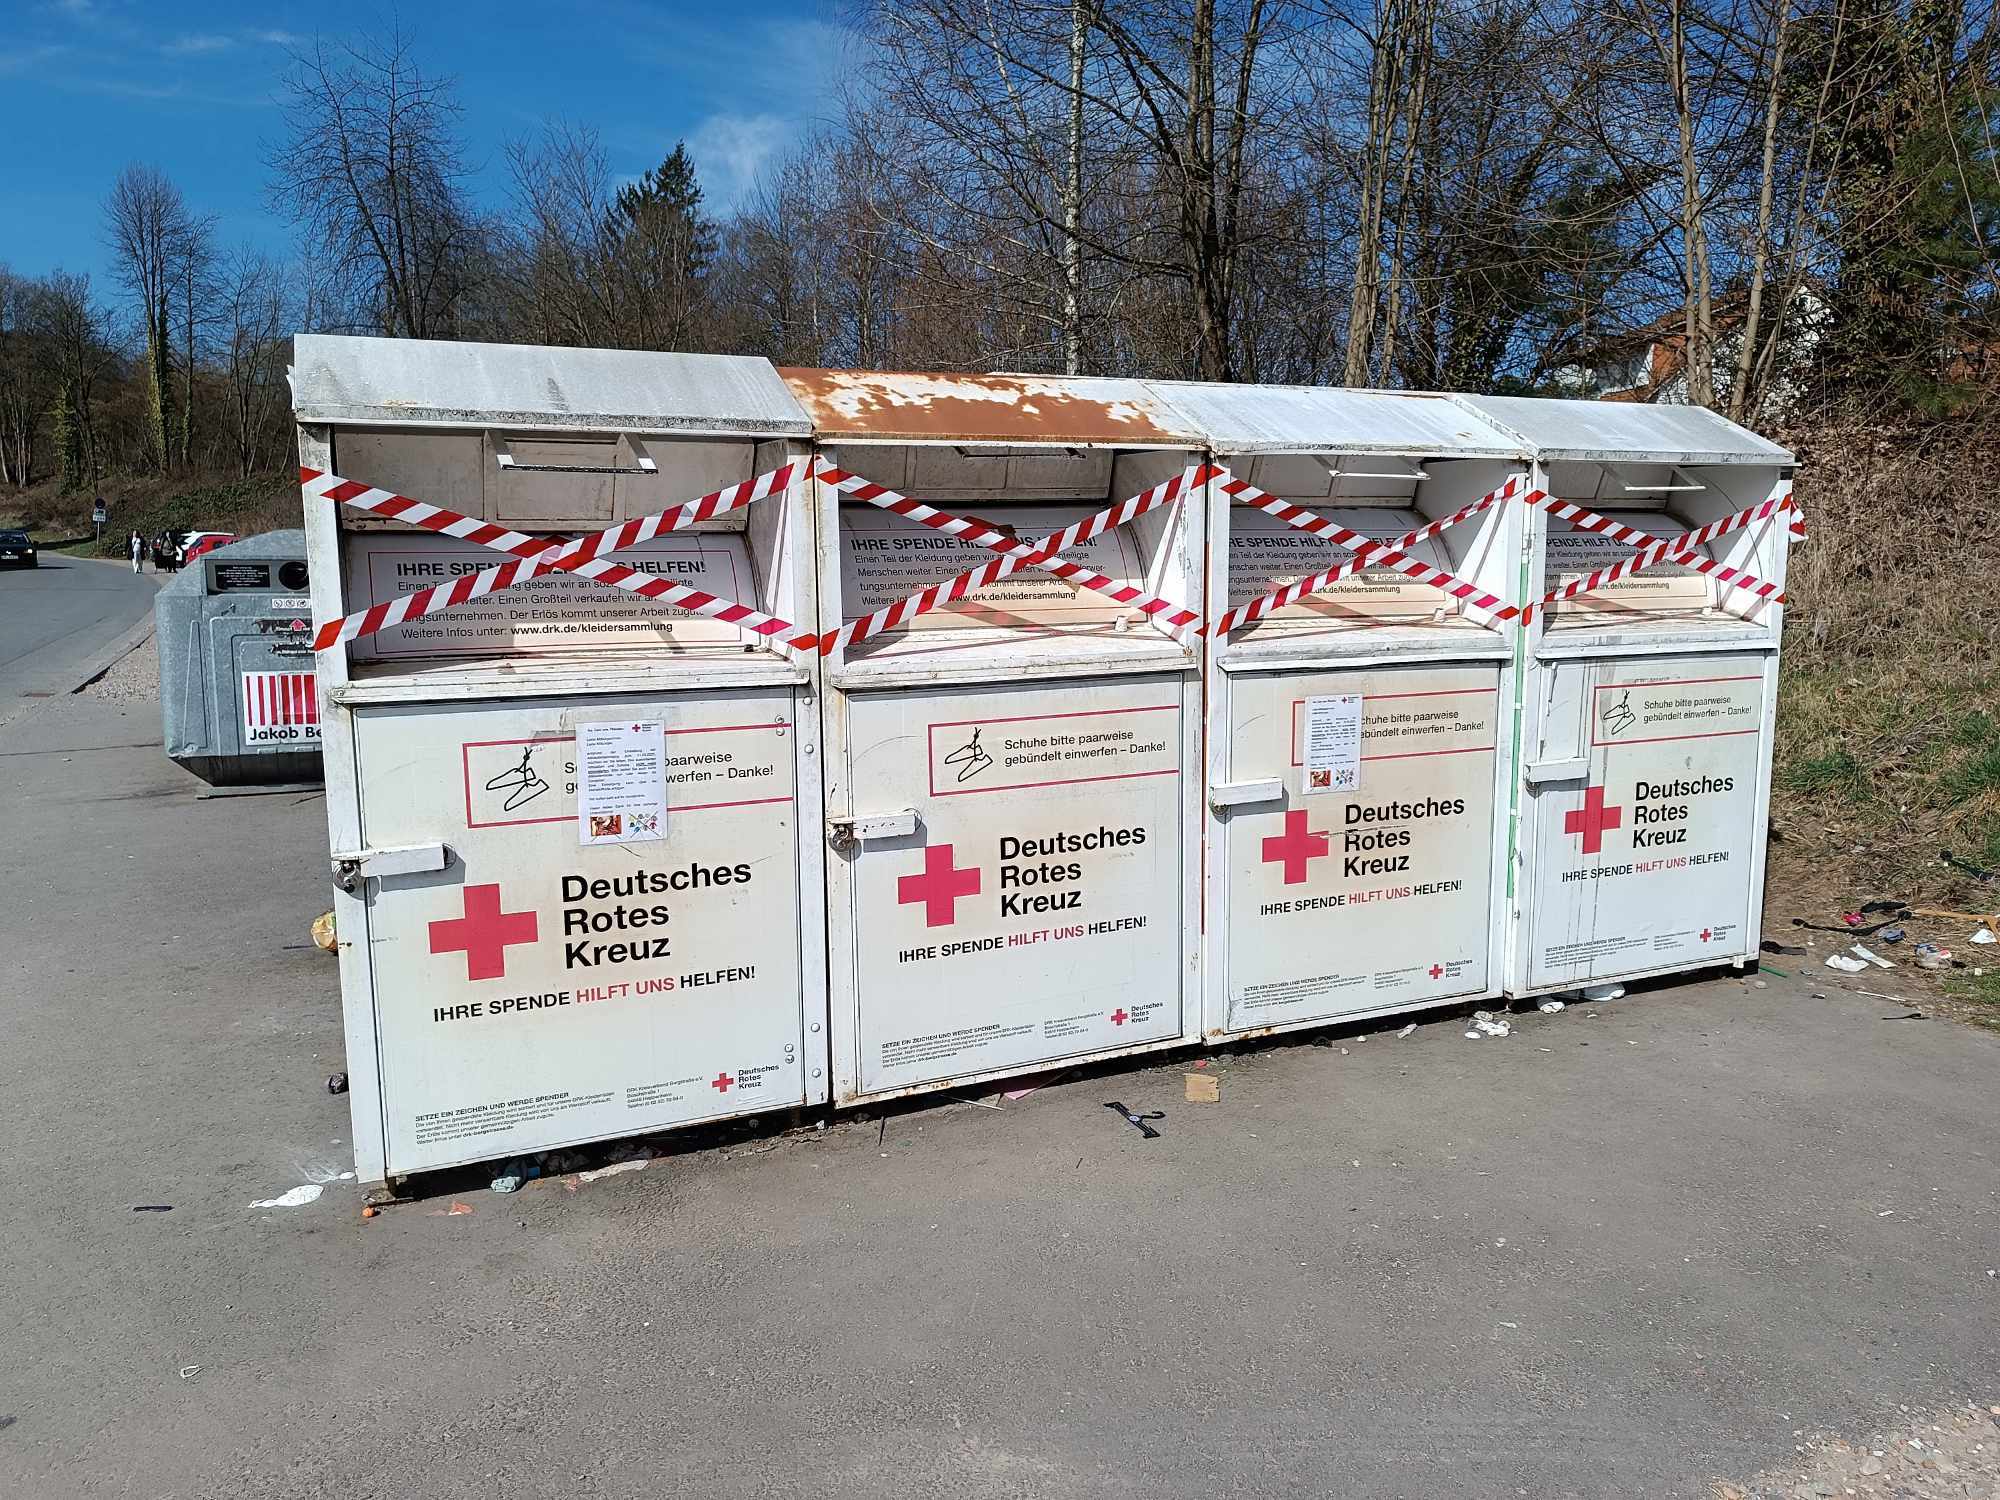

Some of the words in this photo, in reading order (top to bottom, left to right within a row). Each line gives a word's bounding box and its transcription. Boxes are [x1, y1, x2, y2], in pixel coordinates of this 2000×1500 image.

[851, 538, 891, 551] IHRE
[893, 537, 955, 550] SPENDE
[1248, 536, 1299, 548] SPENDE
[1547, 537, 1581, 548] PENDE
[1584, 537, 1609, 547] HILFT
[855, 554, 880, 564] Einen
[881, 554, 896, 563] Teil
[899, 553, 913, 563] der
[915, 553, 953, 564] Kleidung
[955, 553, 980, 563] geben
[982, 553, 994, 561] wir
[1284, 561, 1303, 570] Einen
[397, 562, 444, 577] IHRE
[632, 561, 706, 575] HELFEN!
[857, 568, 903, 577] Menschen
[936, 566, 959, 575] Einen
[398, 581, 429, 591] Einen
[521, 580, 557, 592] geben
[561, 580, 576, 589] wir
[578, 581, 591, 589] an
[499, 594, 528, 605] Einen
[531, 593, 572, 604] Großteil
[575, 592, 625, 603] verkaufen
[627, 592, 641, 602] wir
[862, 595, 895, 606] Weitere
[511, 610, 528, 621] Der
[532, 608, 558, 620] Erlös
[561, 608, 597, 618] kommt
[600, 608, 638, 618] unserer
[641, 606, 669, 617] Arbeit
[402, 627, 443, 639] Weitere
[447, 626, 474, 637] Infos
[477, 625, 507, 637] unter:
[510, 622, 673, 634] www.drk.de/kleidersammlung
[1644, 700, 1673, 709] Schuhe
[1675, 699, 1692, 708] bitte
[1693, 696, 1731, 708] paarweise
[1391, 713, 1411, 723] bitte
[1414, 710, 1459, 723] paarweise
[1643, 711, 1682, 724] gebündelt
[1684, 708, 1720, 719] einwerfen
[1728, 706, 1752, 716] Danke!
[250, 727, 299, 741] Jakob
[1402, 724, 1445, 736] einwerfen
[1455, 720, 1484, 732] Danke!
[1004, 738, 1048, 750] Schuhe
[1050, 735, 1075, 746] bitte
[1078, 730, 1134, 745] paarweise
[1004, 750, 1061, 767] gebündelt
[1065, 745, 1118, 760] einwerfen
[1129, 740, 1166, 754] Danke!
[728, 764, 774, 780] Danke!
[1636, 776, 1734, 800] Deutsches
[1345, 797, 1465, 825] Deutsches
[1634, 804, 1688, 824] Rotes
[1000, 826, 1146, 860] Deutsches
[1344, 829, 1410, 852] Rotes
[1633, 828, 1687, 848] Kreuz
[1344, 855, 1410, 877] Kreuz
[1562, 869, 1588, 882] IHRE
[1590, 864, 1632, 878] SPENDE
[1635, 860, 1664, 873] HILFT
[1666, 857, 1686, 868] UNS
[1689, 851, 1729, 865] HELFEN!
[561, 862, 752, 903] Deutsches
[1001, 862, 1082, 889] Rotes
[1001, 890, 1082, 918] Kreuz
[1261, 902, 1291, 915] IHRE
[1294, 895, 1345, 912] SPENDE
[1349, 890, 1382, 904] HILFT
[1385, 886, 1411, 899] UNS
[1414, 880, 1462, 895] HELFEN!
[563, 903, 670, 936] Rotes
[899, 947, 937, 963] IHRE
[941, 936, 1004, 958] SPENDE
[1008, 930, 1049, 947] HILFT
[1054, 925, 1084, 940] UNS
[1088, 916, 1147, 935] HELFEN!
[565, 936, 671, 970] Kreuz
[433, 1002, 483, 1022] IHRE
[489, 991, 571, 1016] SPENDE
[576, 983, 630, 1004] HILFT
[636, 977, 675, 996] UNS
[680, 965, 756, 990] HELFEN!
[1131, 1001, 1163, 1012] Deutsches
[1131, 1010, 1149, 1018] Rotes
[738, 1065, 780, 1076] Deutsches
[738, 1074, 762, 1083] Rotes
[738, 1081, 762, 1089] Kreuz
[440, 1110, 454, 1118] EIN
[455, 1105, 488, 1116] ZEICHEN
[489, 1102, 506, 1110] UND
[507, 1097, 534, 1107] WERDE
[535, 1092, 569, 1103] SPENDER
